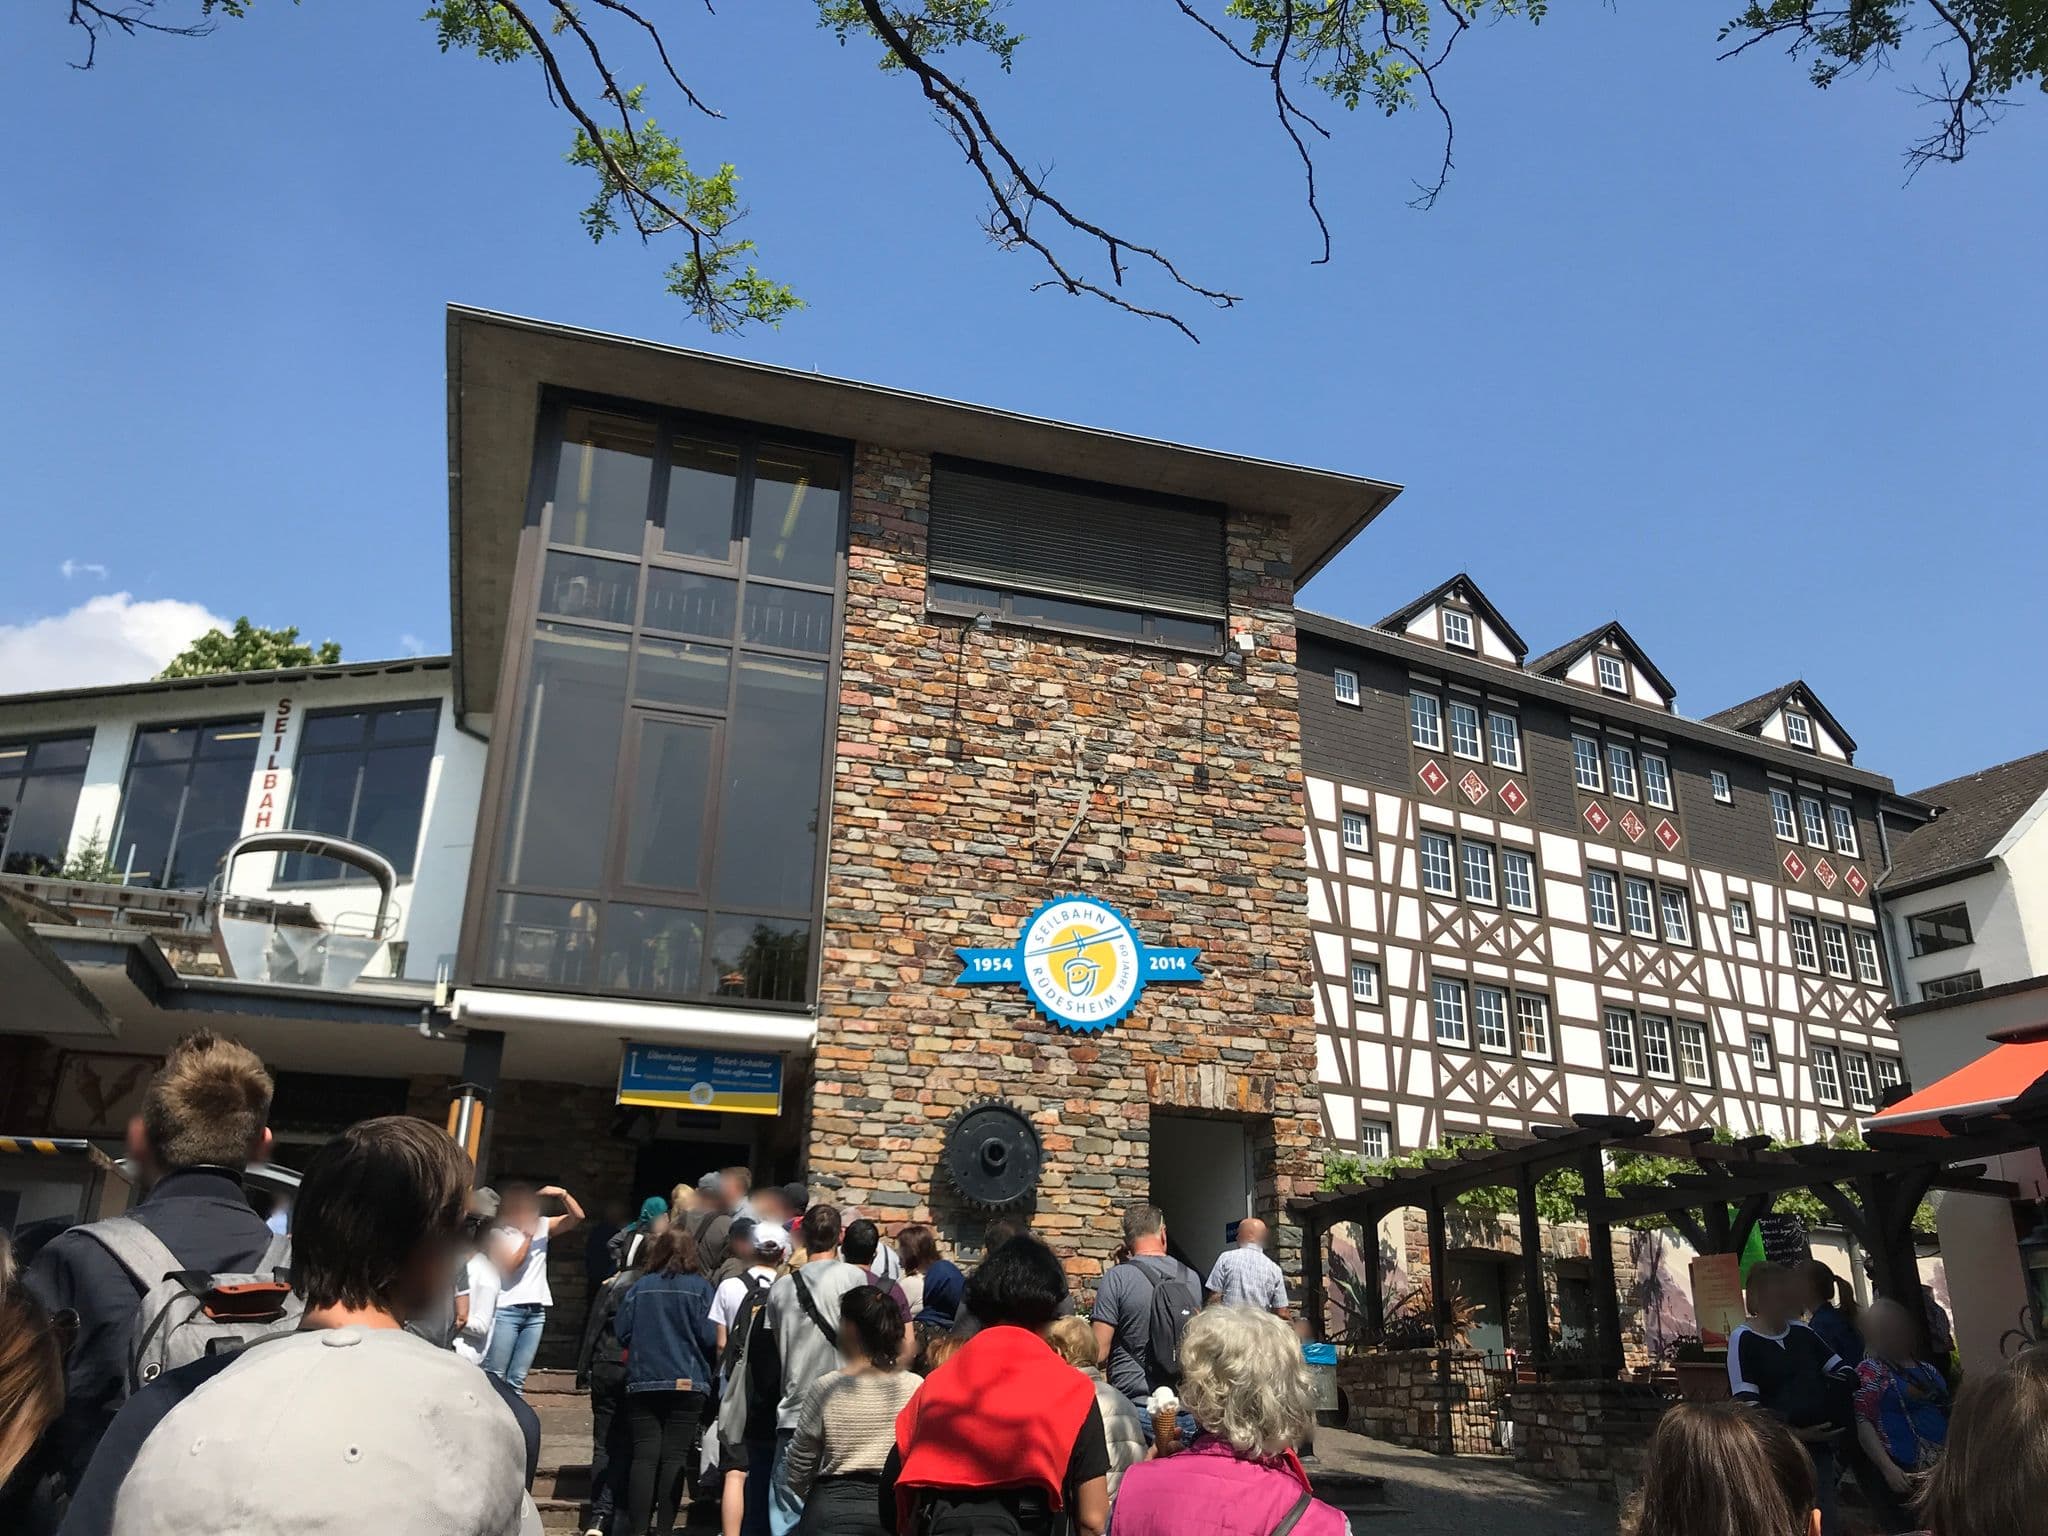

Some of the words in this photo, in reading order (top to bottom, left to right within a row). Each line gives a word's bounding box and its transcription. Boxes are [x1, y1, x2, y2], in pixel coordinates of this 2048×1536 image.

[255, 698, 292, 828] SEILBAH
[1034, 908, 1106, 944] SEILBAHN
[973, 958, 1013, 971] 1954
[1119, 944, 1129, 957] 60
[1149, 957, 1186, 970] 2014
[1033, 967, 1117, 1014] RÜDESHEIM
[1118, 960, 1130, 991] JAHRE
